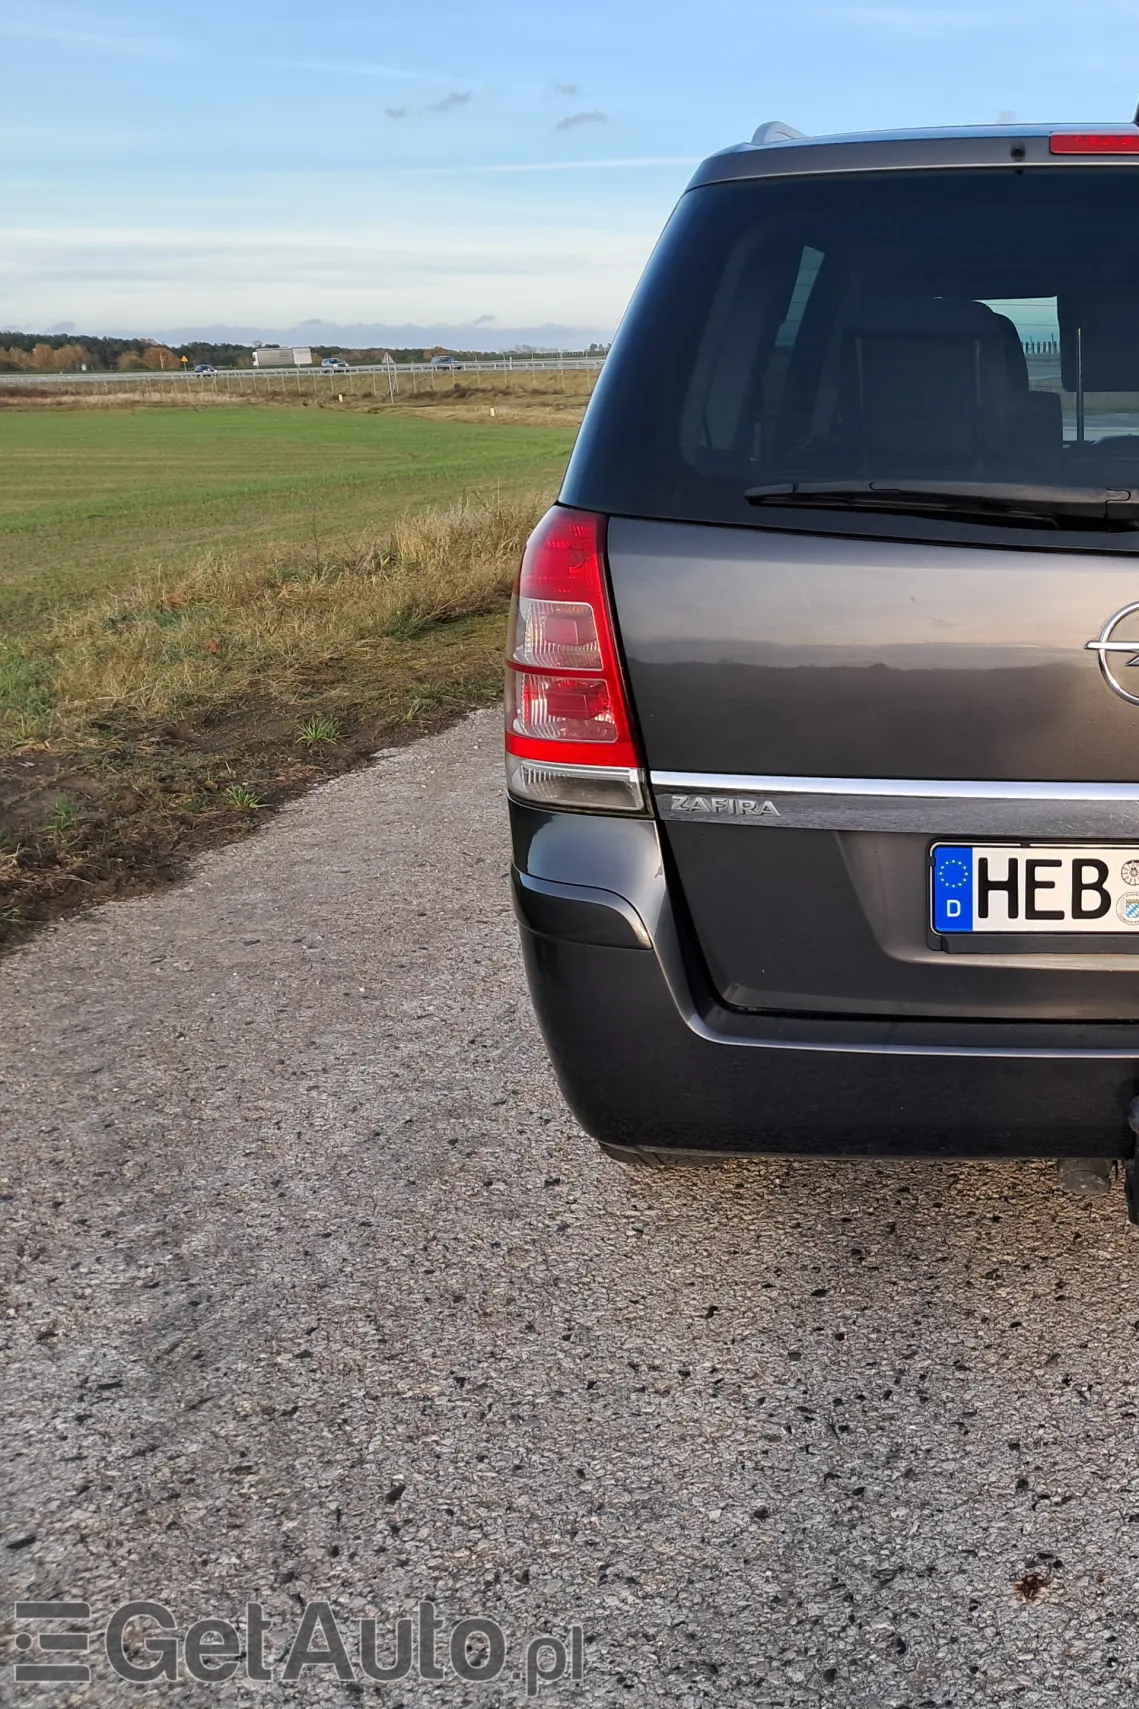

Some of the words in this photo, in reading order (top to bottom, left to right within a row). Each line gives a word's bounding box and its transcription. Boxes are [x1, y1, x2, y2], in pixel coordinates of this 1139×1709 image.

[671, 795, 781, 817] ZAFIRA
[977, 857, 1111, 920] HEB
[946, 899, 961, 918] D
